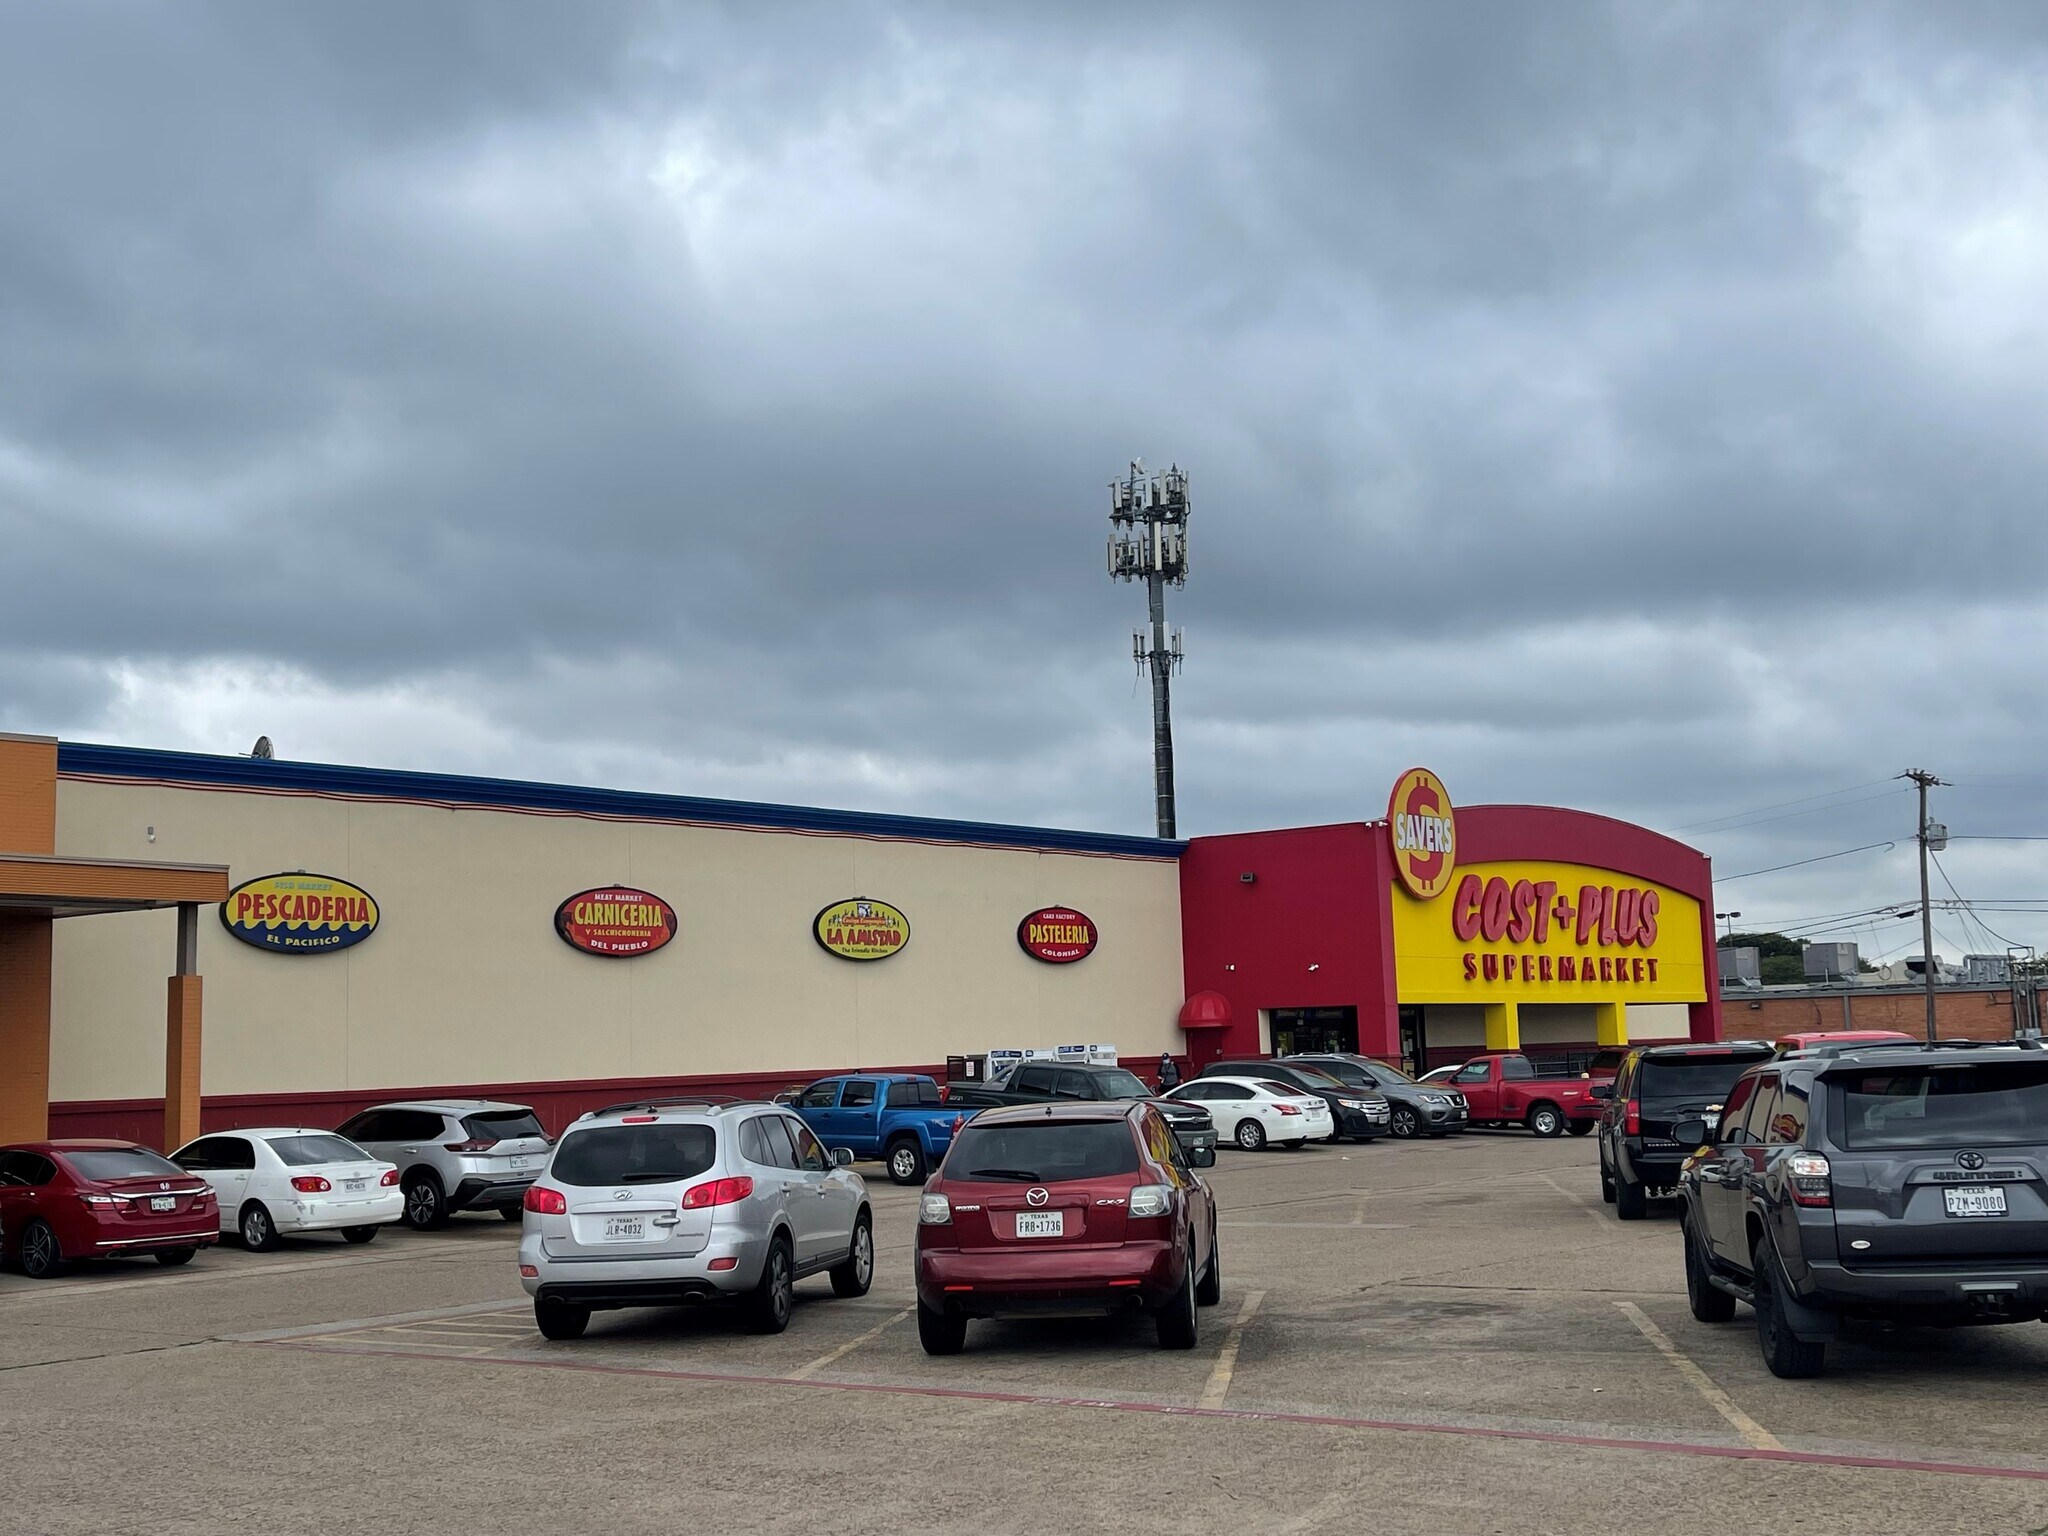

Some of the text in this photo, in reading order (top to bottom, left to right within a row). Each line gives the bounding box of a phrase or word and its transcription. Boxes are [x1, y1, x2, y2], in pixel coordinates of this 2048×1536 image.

[1396, 812, 1453, 854] SAVERS
[594, 893, 643, 902] MEAT MARKET
[237, 893, 370, 922] PESCADERIA
[574, 902, 663, 927] CARNICERIA
[266, 934, 340, 947] EL PACIFICO
[826, 928, 902, 946] LA AMISTAD
[1029, 924, 1090, 944] PASTELERIA
[591, 939, 649, 951] DEL PUEBLO
[1041, 948, 1080, 957] COLONIAL
[1463, 953, 1659, 982] SUPERMARKET
